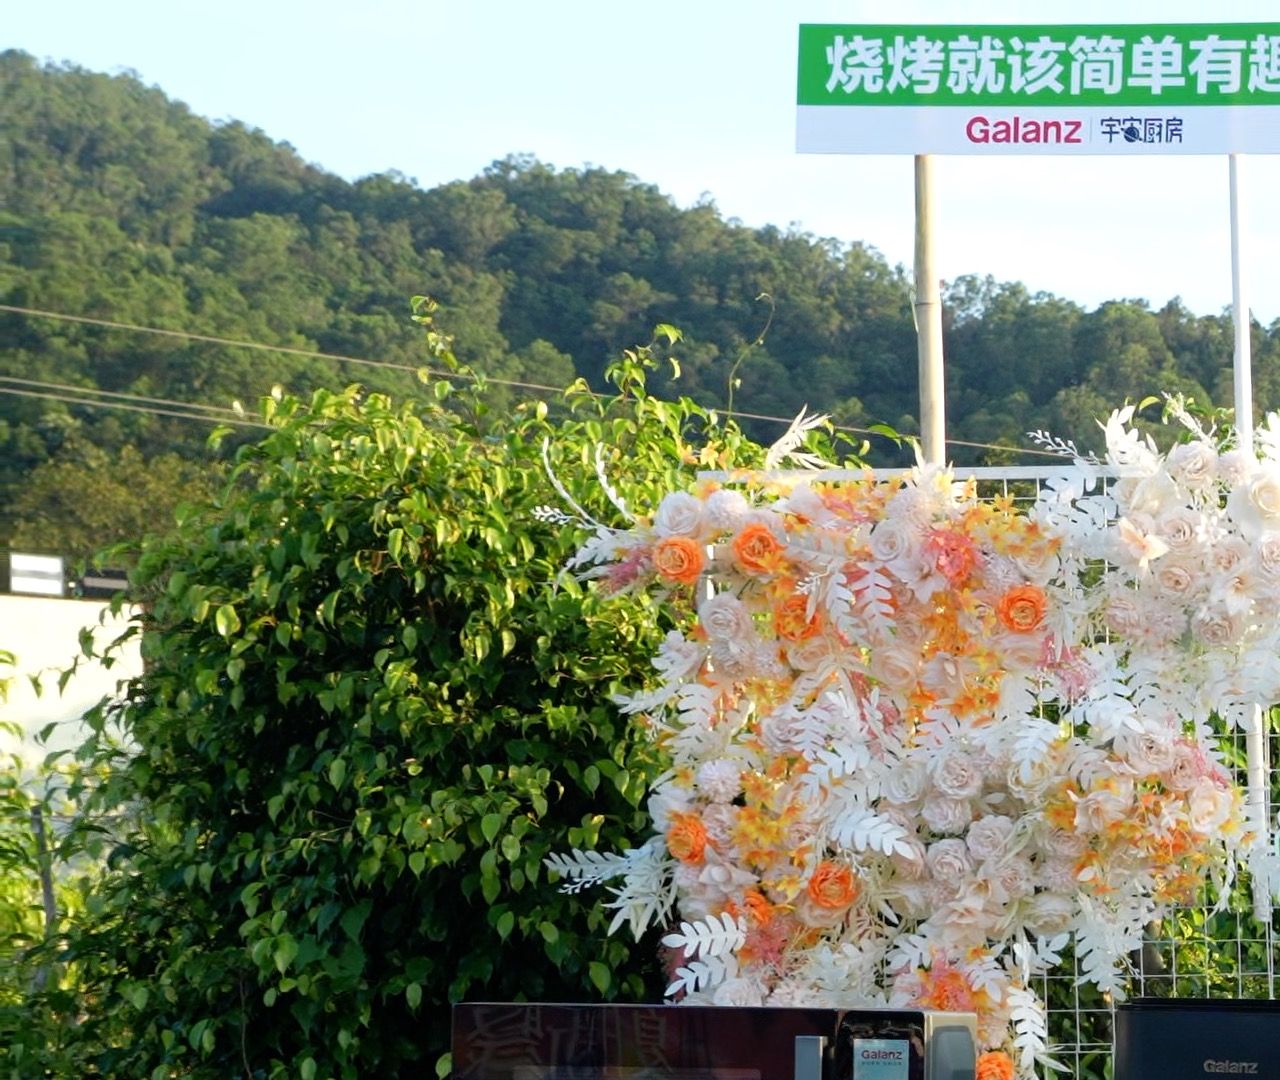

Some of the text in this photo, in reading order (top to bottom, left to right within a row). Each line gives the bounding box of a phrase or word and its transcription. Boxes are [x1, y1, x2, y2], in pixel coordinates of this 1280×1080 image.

[966, 116, 1082, 144] Galanz
[1100, 117, 1183, 143] 宇宙厨房
[861, 1050, 903, 1060] Galanz
[1203, 1059, 1258, 1074] Galanz
